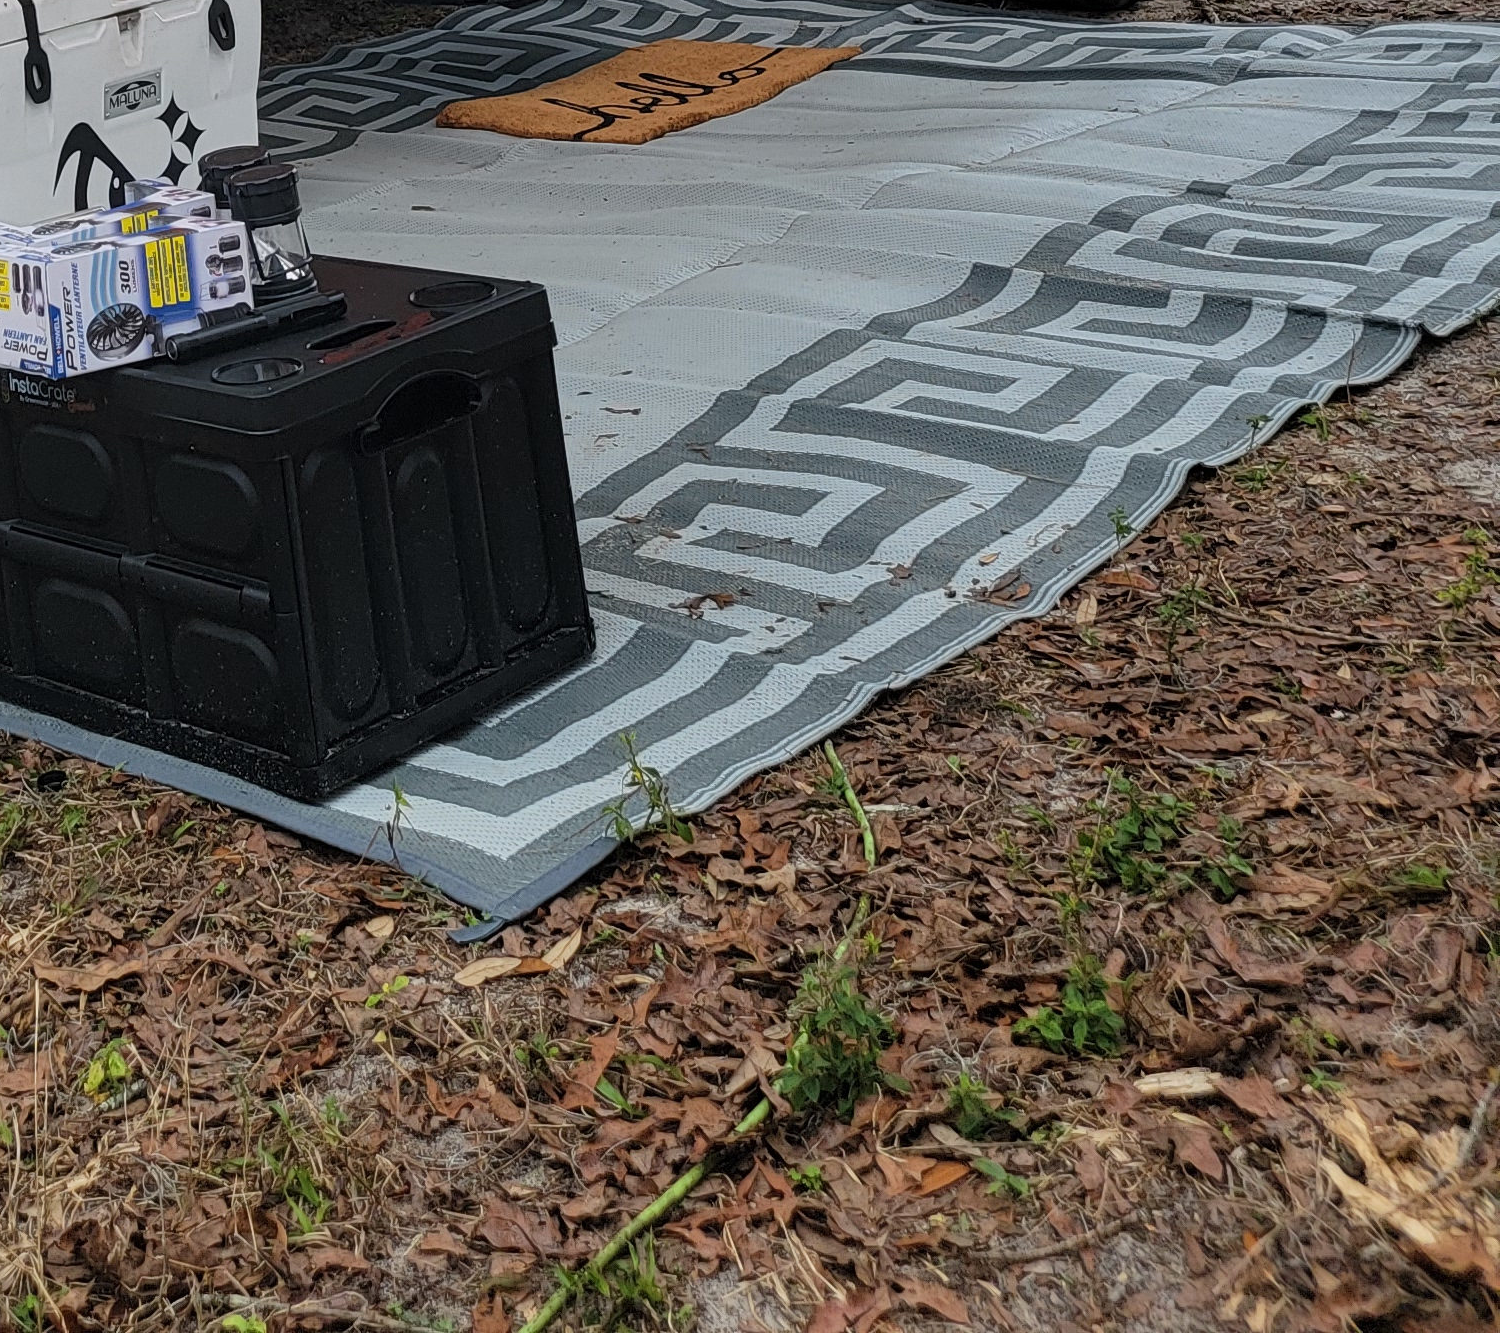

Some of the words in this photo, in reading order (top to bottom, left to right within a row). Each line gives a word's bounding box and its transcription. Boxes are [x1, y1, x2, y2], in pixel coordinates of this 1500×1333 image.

[109, 84, 157, 110] MALUNA
[540, 47, 786, 141] hello
[70, 261, 82, 309] LANTERNE
[118, 260, 131, 294] 300
[3, 328, 33, 341] LANTERN
[33, 334, 48, 346] FAN
[62, 285, 78, 372] POWER
[75, 311, 87, 371] VENTILATEUR
[3, 339, 48, 361] POWER
[8, 371, 76, 403] InstaCrate
